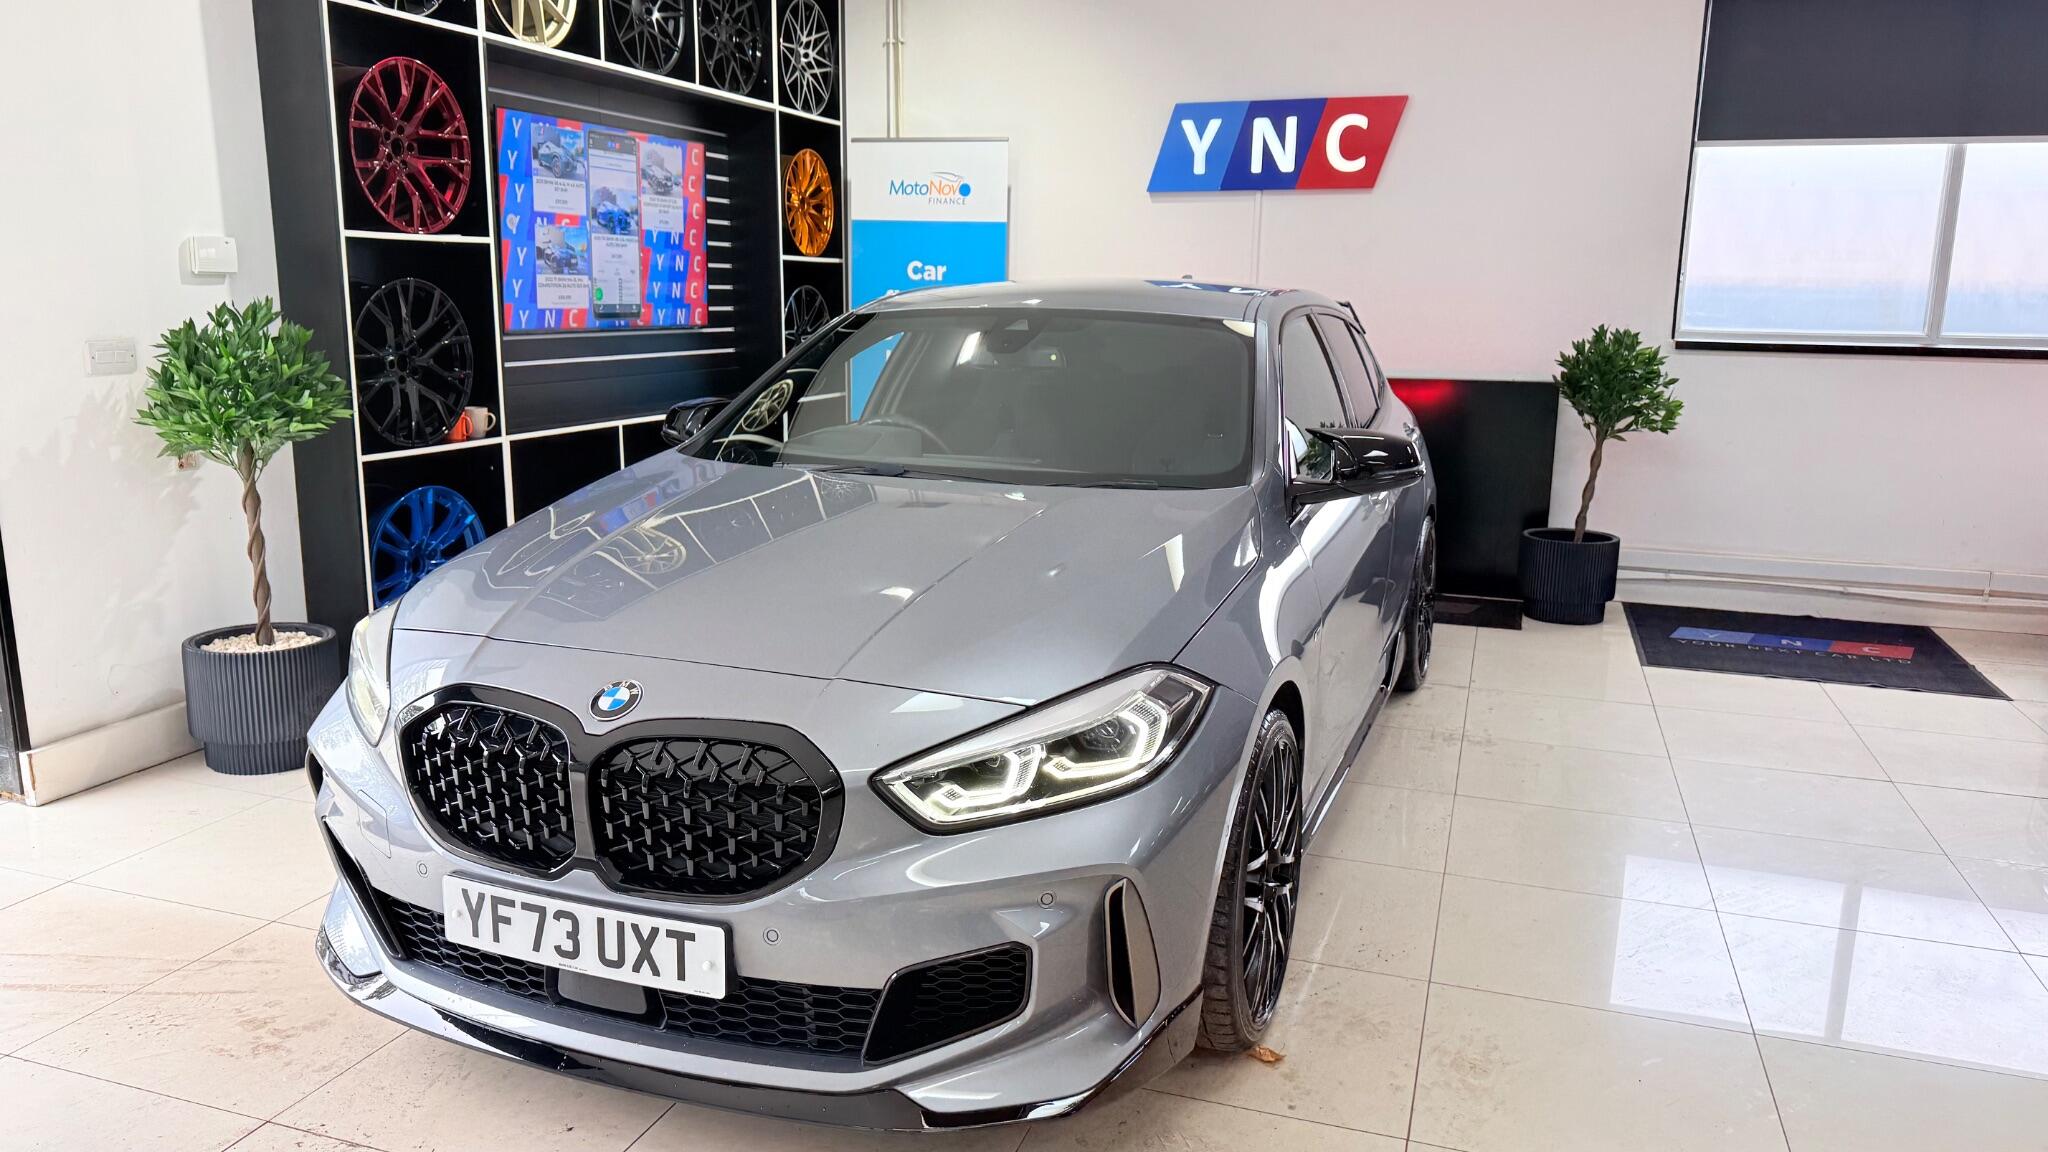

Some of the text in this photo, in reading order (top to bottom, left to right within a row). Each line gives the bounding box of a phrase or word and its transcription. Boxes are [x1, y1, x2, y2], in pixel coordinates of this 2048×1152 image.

[1180, 113, 1369, 175] YNC
[907, 260, 947, 281] Car
[461, 887, 696, 982] YF73 UXT
